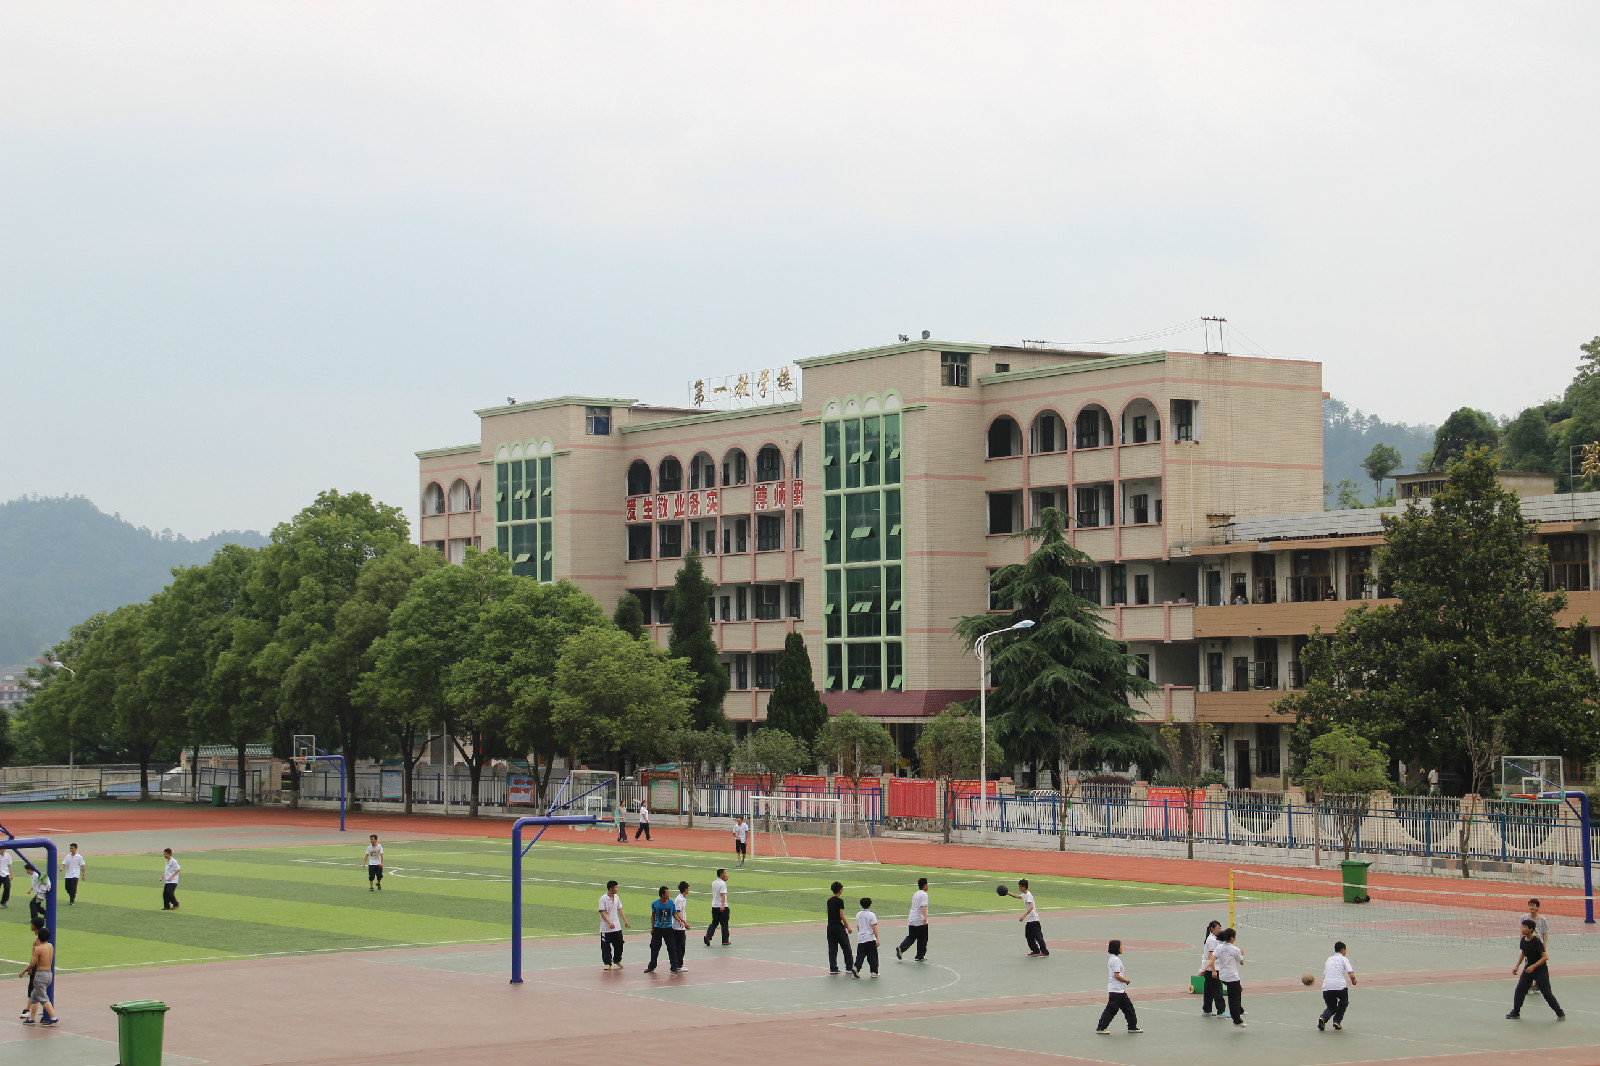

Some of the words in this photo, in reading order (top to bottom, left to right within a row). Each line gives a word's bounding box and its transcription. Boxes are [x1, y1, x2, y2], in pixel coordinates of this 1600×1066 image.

[626, 491, 718, 521] 爱生敬业务实
